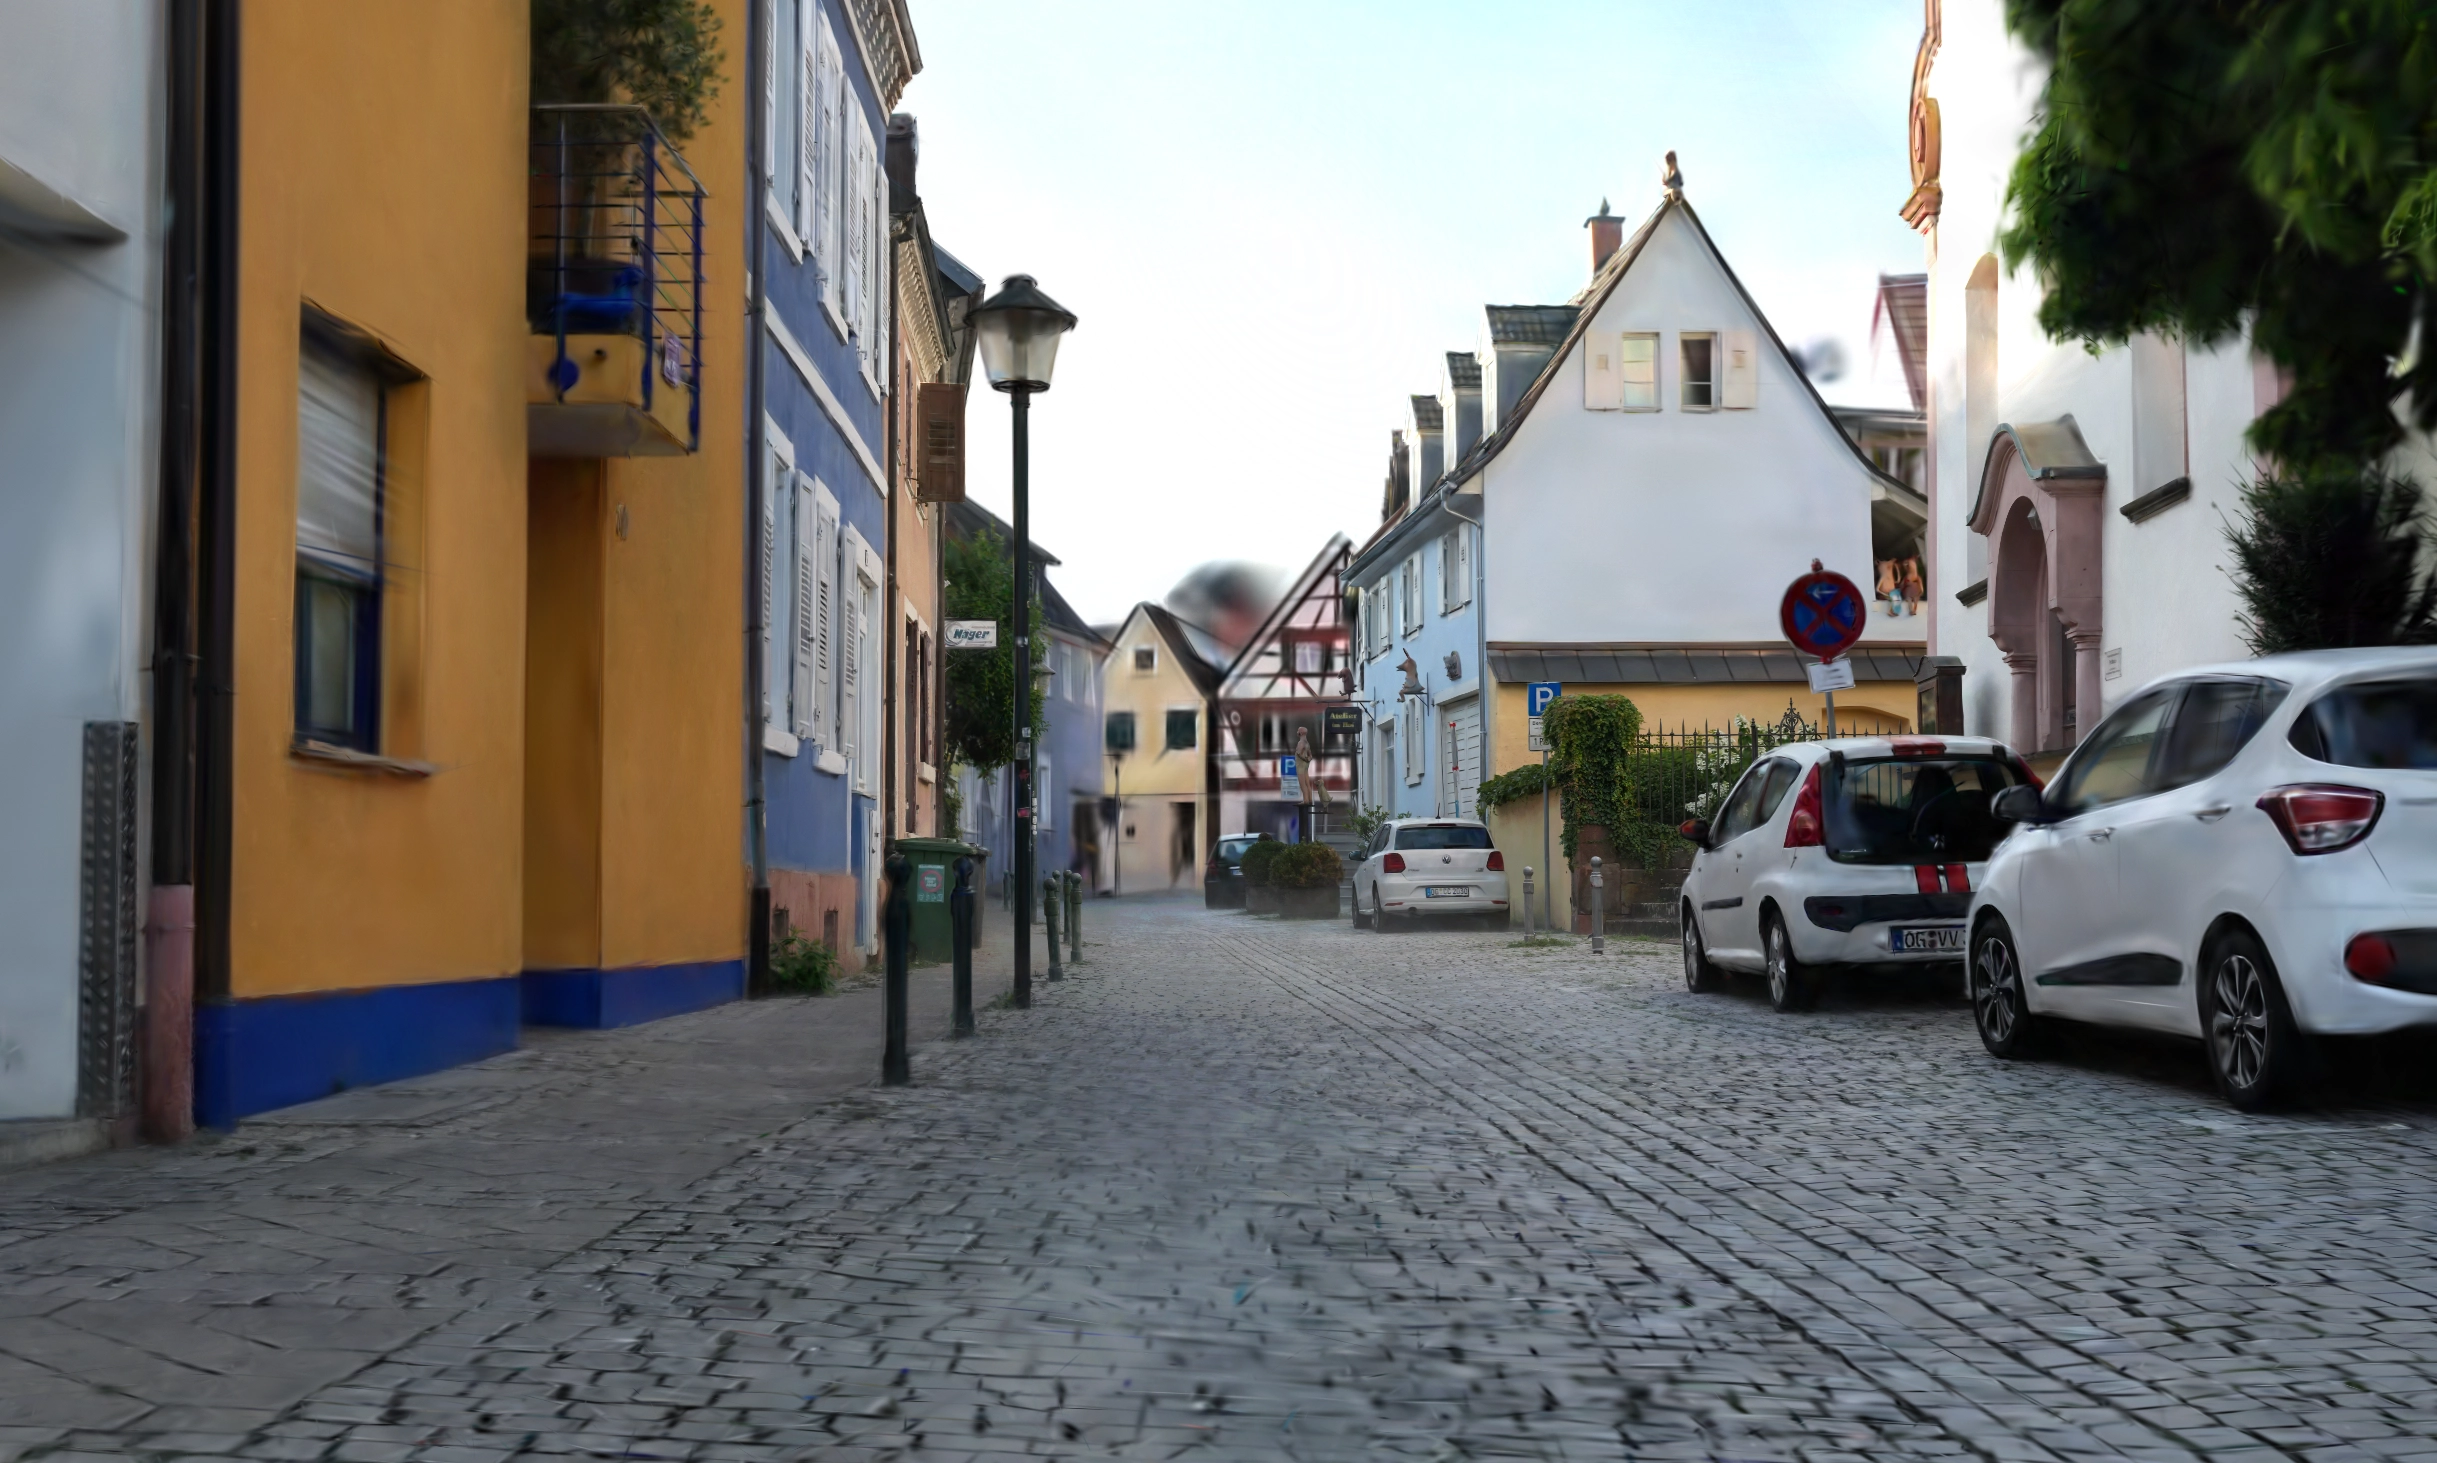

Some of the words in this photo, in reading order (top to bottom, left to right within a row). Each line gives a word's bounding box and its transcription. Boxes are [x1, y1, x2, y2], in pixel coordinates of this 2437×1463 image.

[1535, 687, 1554, 712] P
[1285, 758, 1296, 774] P
[1904, 930, 1926, 948] OG
